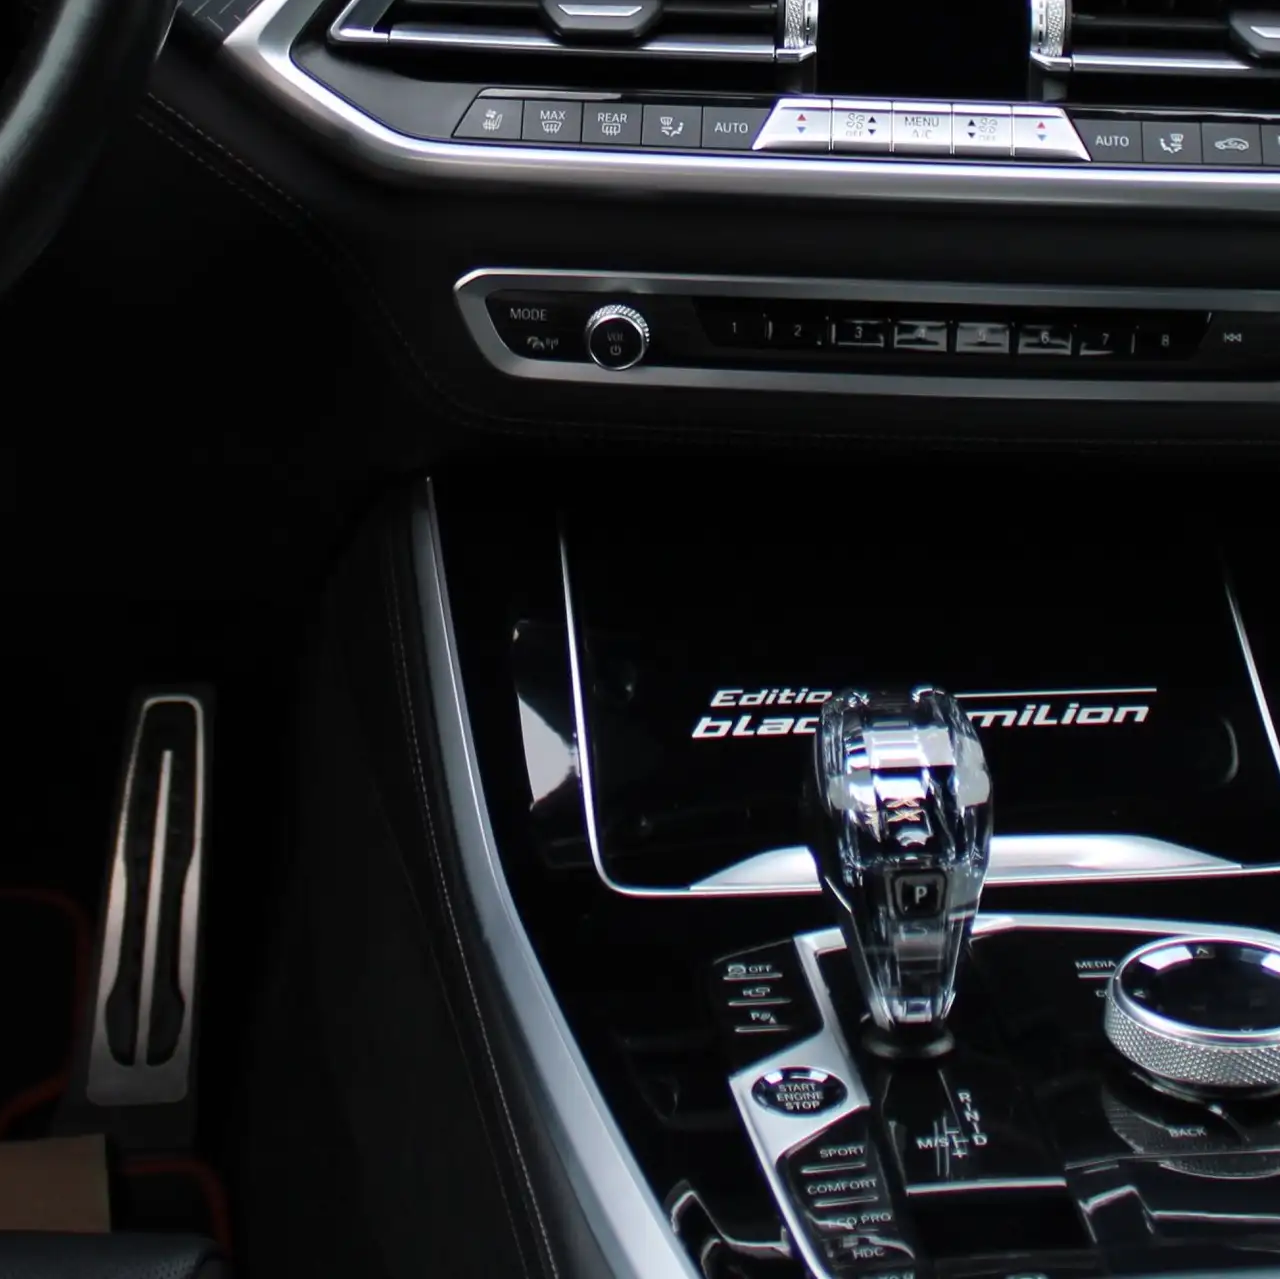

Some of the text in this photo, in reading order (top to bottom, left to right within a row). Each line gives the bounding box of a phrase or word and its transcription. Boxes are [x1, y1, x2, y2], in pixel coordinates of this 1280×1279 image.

[540, 109, 566, 120] MAX
[597, 112, 628, 124] REAR
[714, 121, 749, 134] AUTO
[904, 116, 940, 128] MENU
[911, 129, 933, 139] A/C
[1095, 135, 1130, 147] AUTO
[510, 307, 548, 321] MODE
[793, 324, 802, 337] 2
[854, 326, 863, 339] 3
[1040, 331, 1050, 344] 6
[1102, 333, 1109, 346] 7
[1161, 334, 1170, 347] 8
[710, 688, 832, 707] Editio
[692, 702, 1149, 738] blac milion
[914, 885, 928, 905] P
[748, 964, 773, 973] OFF
[1074, 960, 1116, 969] MEDIA
[778, 1082, 817, 1093] START
[776, 1091, 824, 1102] ENGINE
[958, 1091, 972, 1103] R
[785, 1101, 821, 1111] STOP
[964, 1110, 980, 1122] N
[1168, 1126, 1207, 1138] BACK
[916, 1136, 950, 1149] M/S
[973, 1133, 988, 1146] D
[819, 1145, 866, 1159] SPORT
[807, 1178, 878, 1195] COMFORT
[860, 1211, 892, 1225] PRO
[851, 1246, 885, 1260] HDC
